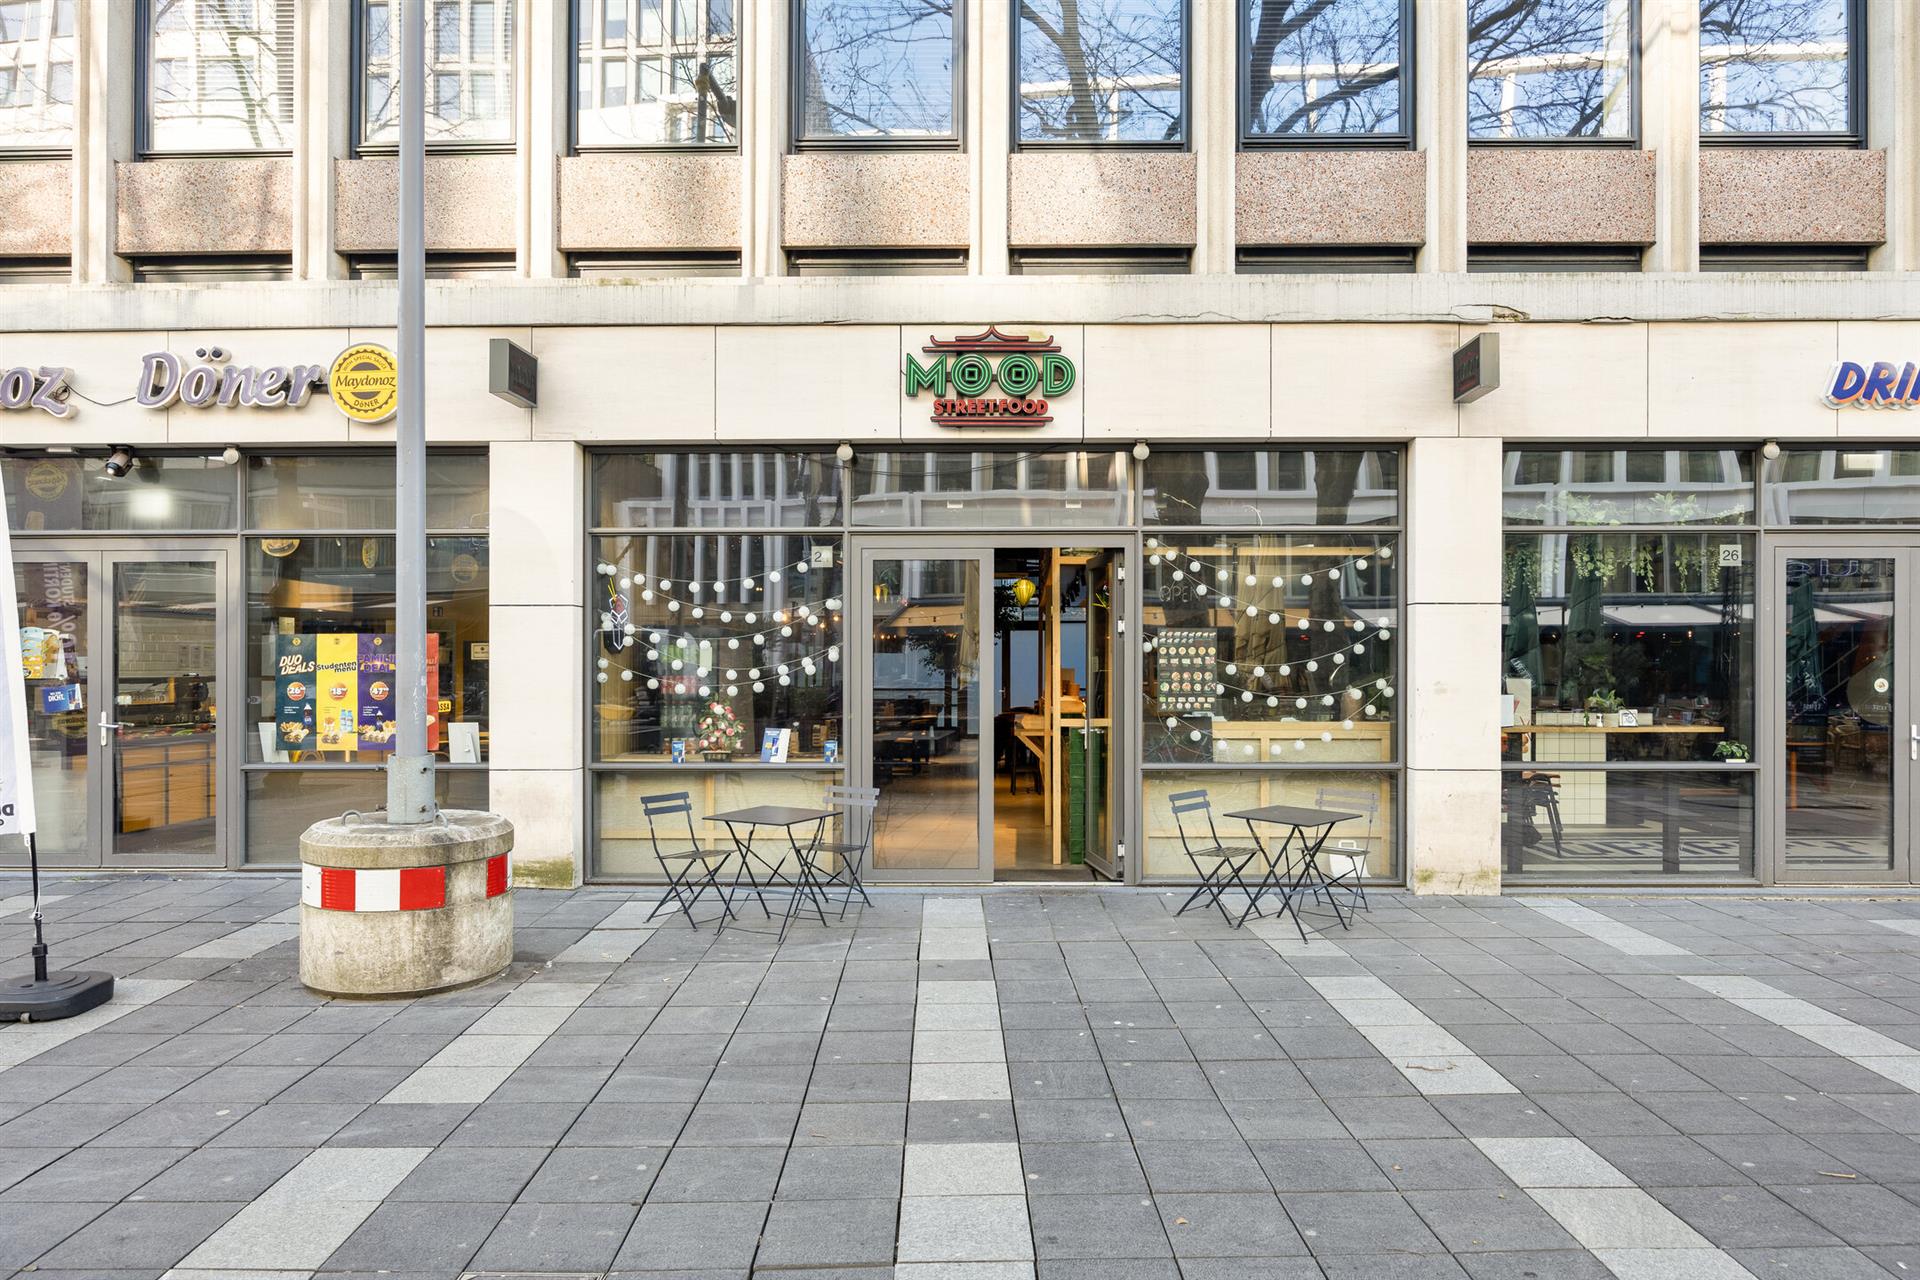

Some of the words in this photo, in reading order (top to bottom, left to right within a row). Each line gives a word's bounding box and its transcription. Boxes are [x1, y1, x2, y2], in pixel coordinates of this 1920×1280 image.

[905, 352, 1077, 397] MOOD
[0, 366, 74, 418] oz
[136, 347, 323, 409] Döner
[335, 375, 396, 390] Maydonoz
[1722, 549, 1739, 561] 26
[279, 654, 303, 668] DUO
[280, 661, 316, 675] DEALS
[316, 661, 357, 671] Studenten
[363, 663, 392, 673] DEAL
[438, 702, 450, 711] SSA
